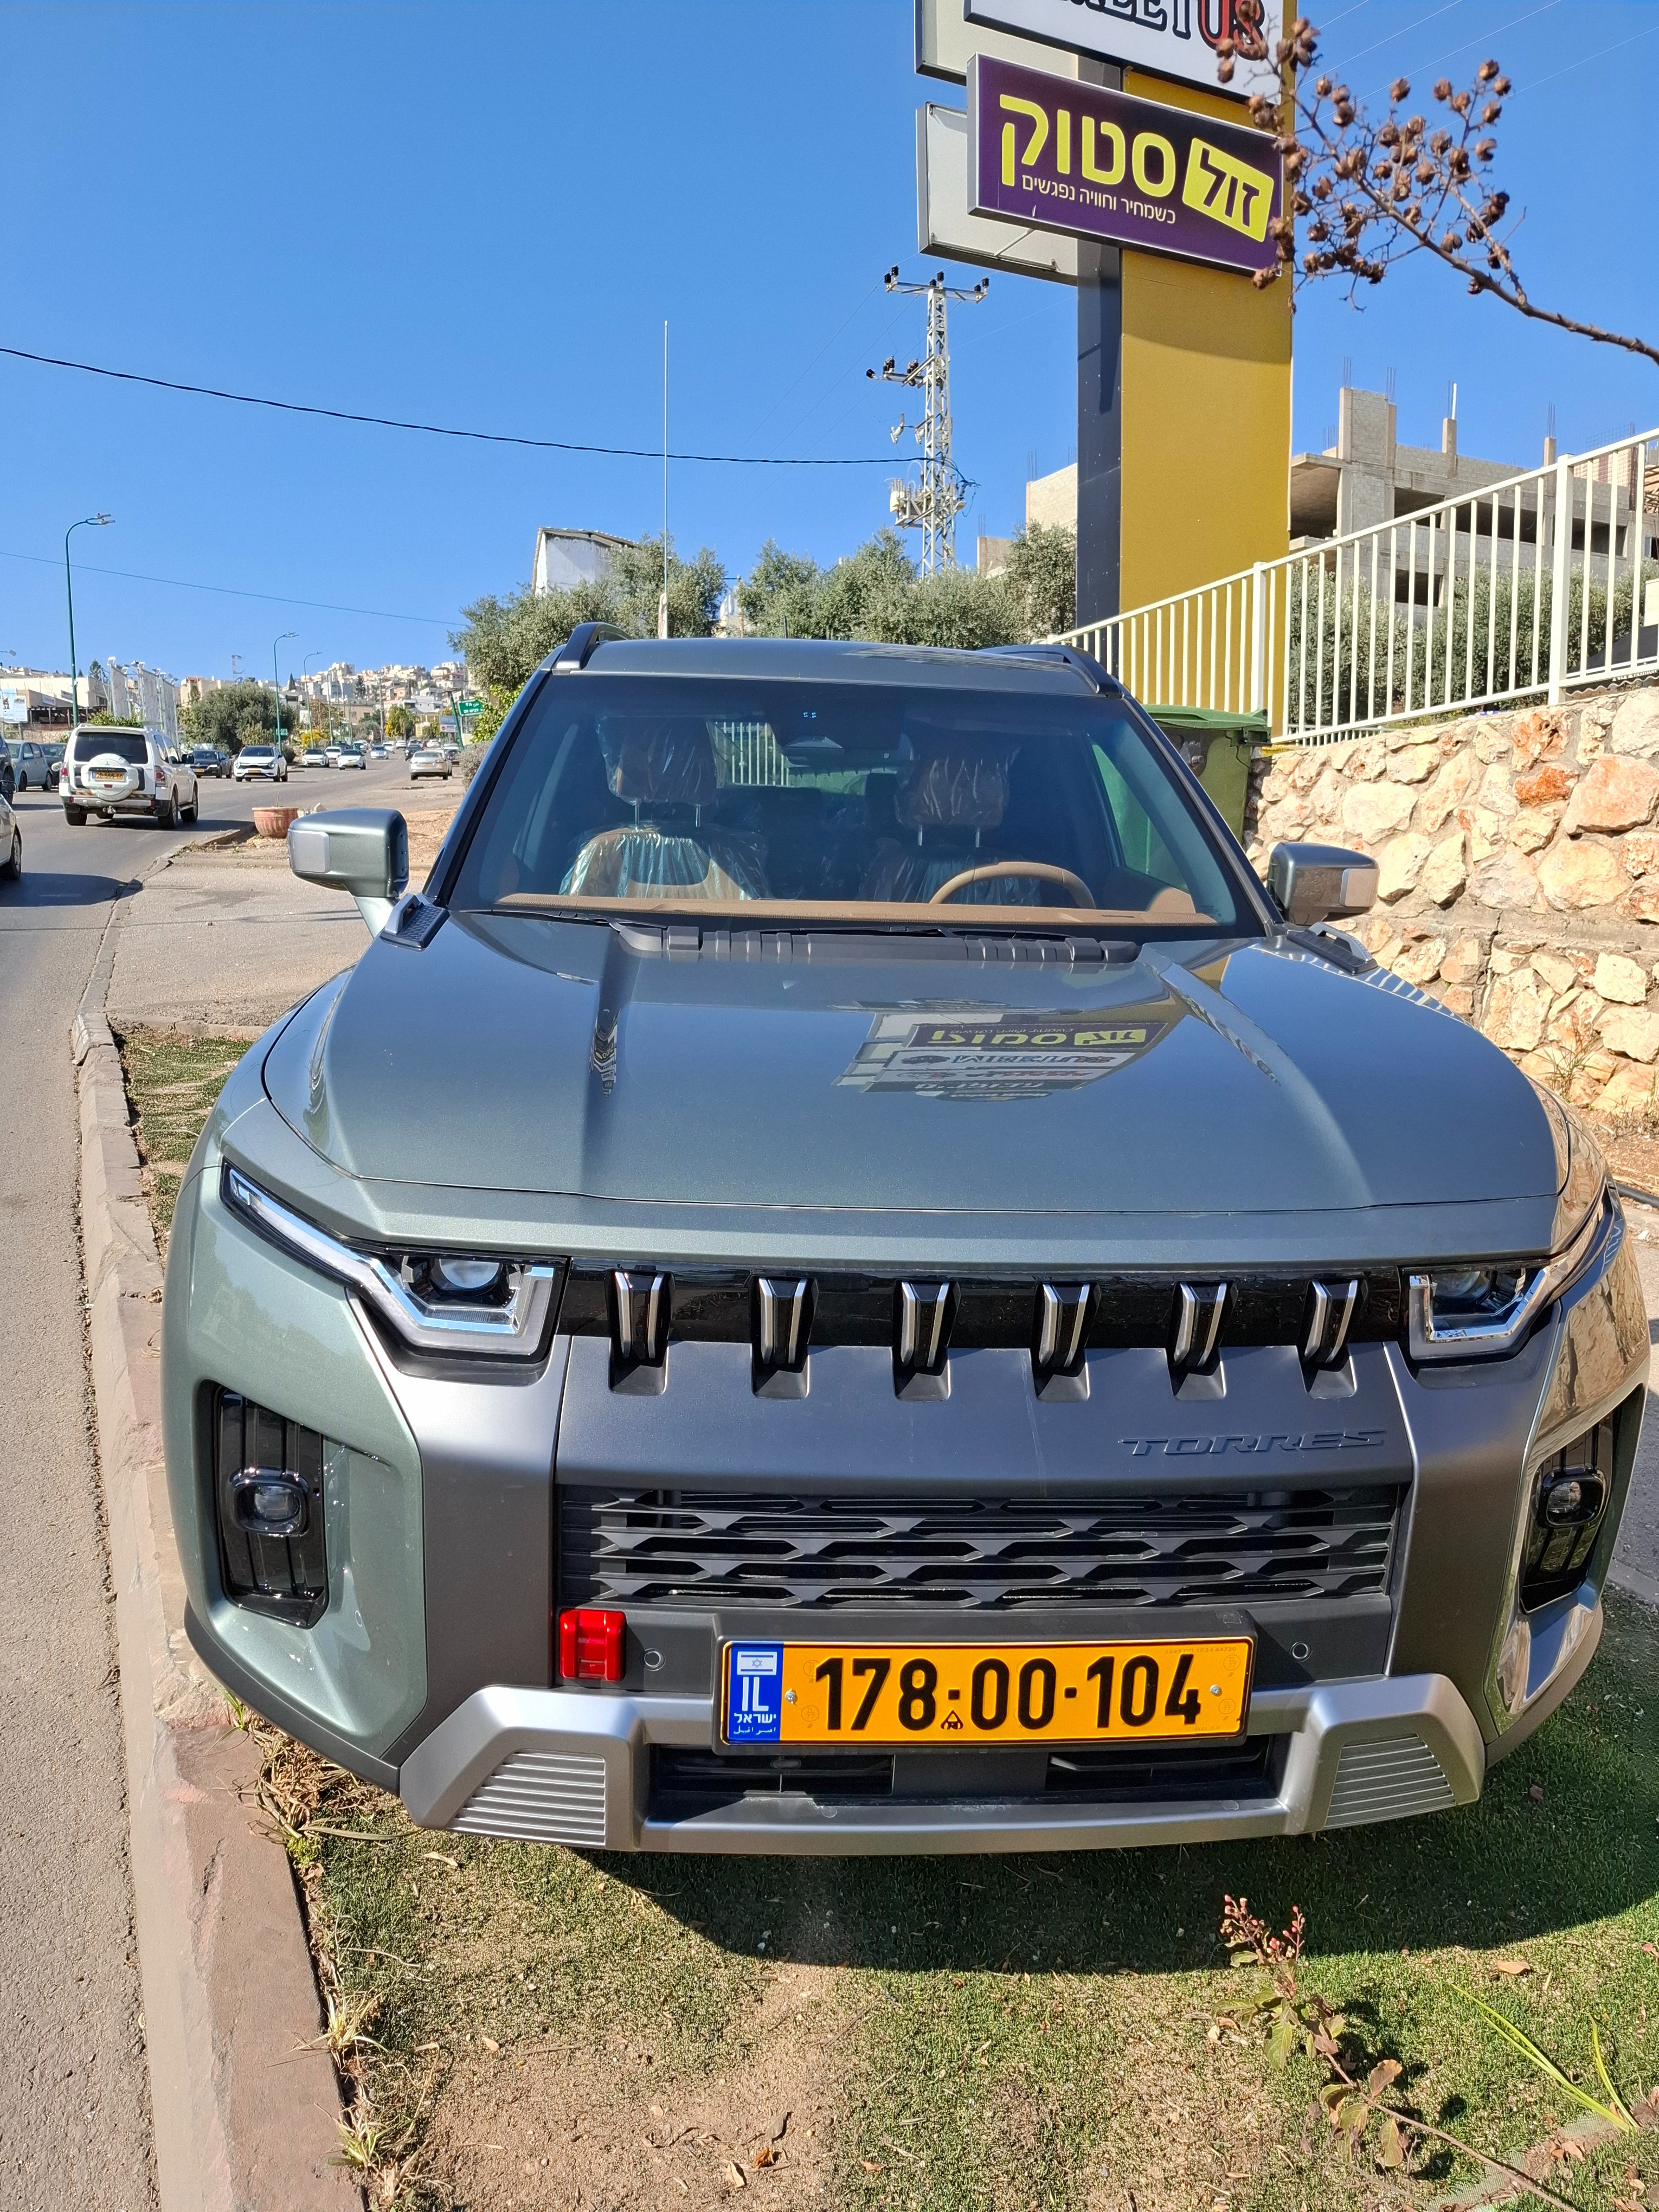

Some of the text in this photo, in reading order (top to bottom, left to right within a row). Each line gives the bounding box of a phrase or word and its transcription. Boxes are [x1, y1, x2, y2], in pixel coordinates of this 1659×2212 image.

[999, 93, 1261, 228] זול סטוק
[1021, 174, 1176, 224] כשמחיר וחוויה נפגשים
[1120, 1430, 1387, 1456] TORRES
[742, 1676, 769, 1711] IL
[734, 1713, 776, 1724] ישראל
